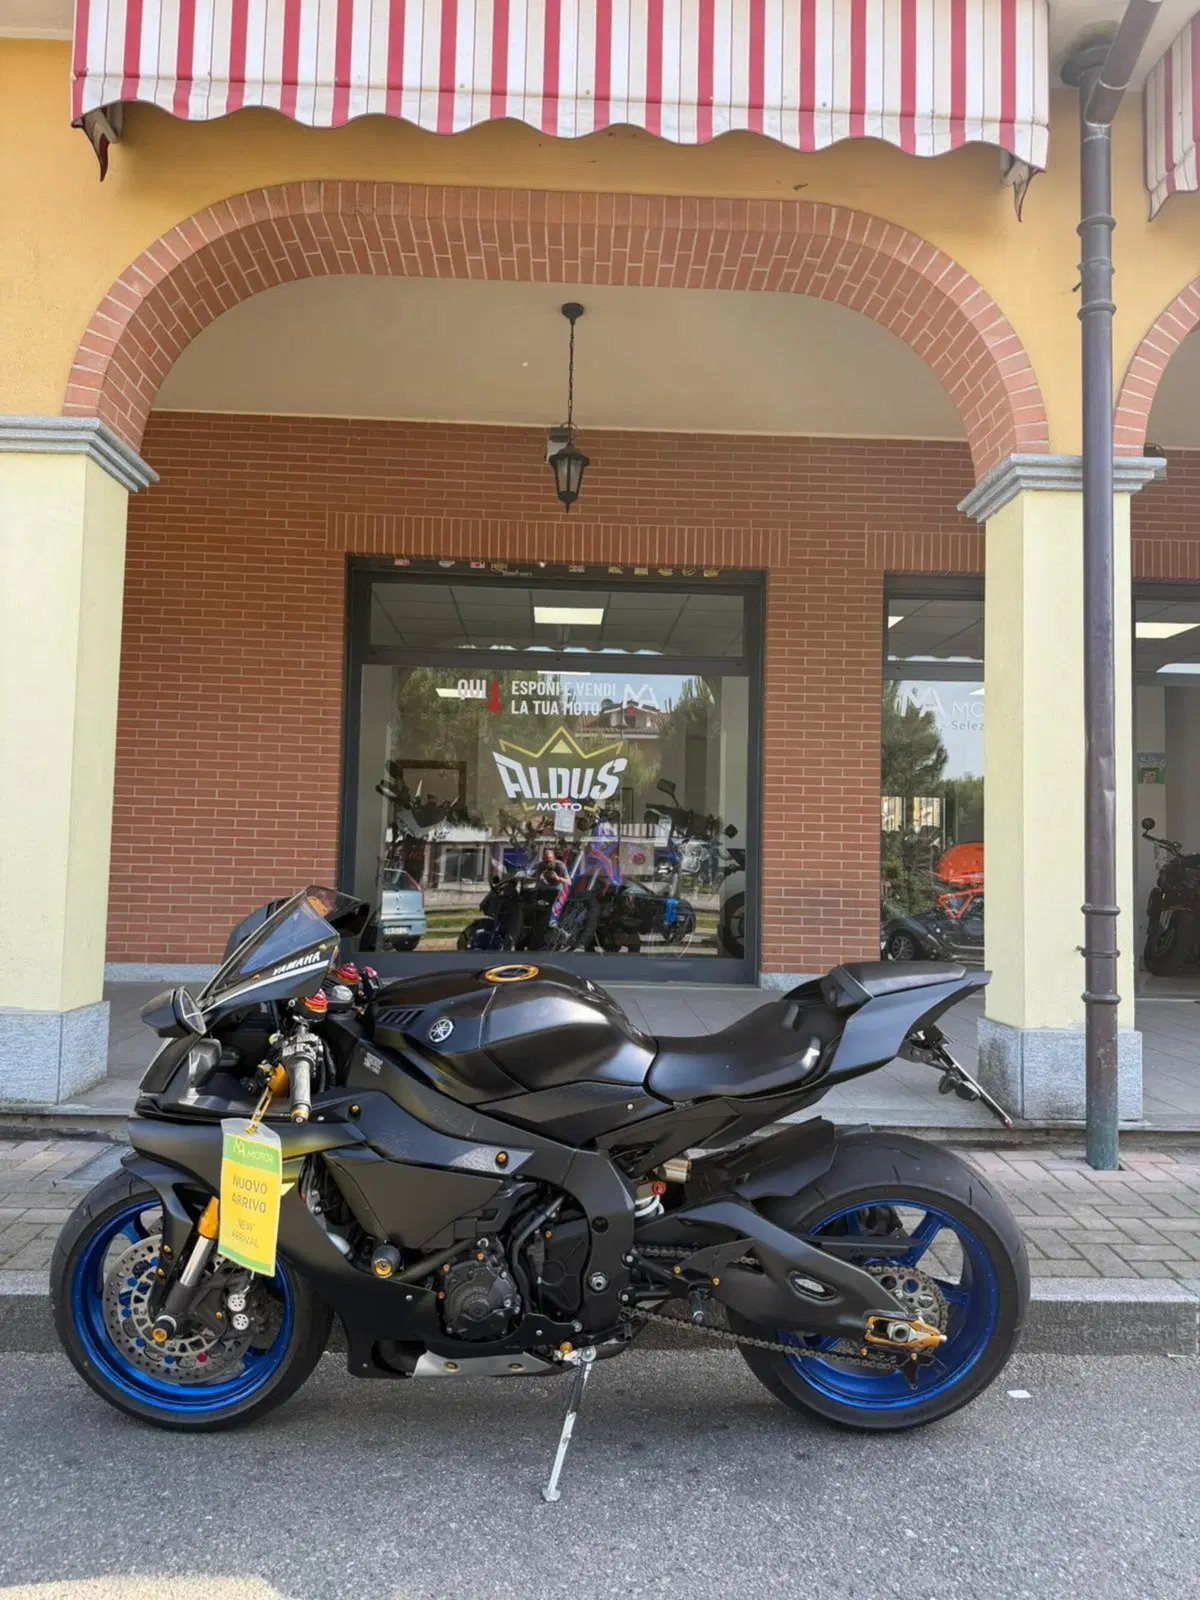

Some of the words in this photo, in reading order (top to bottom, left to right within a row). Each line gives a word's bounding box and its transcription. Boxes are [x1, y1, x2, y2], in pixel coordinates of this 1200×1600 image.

[457, 679, 487, 699] QUI
[511, 680, 560, 696] ESPONI
[565, 682, 573, 697] E
[576, 682, 616, 697] VENDI
[511, 700, 529, 714] LA
[533, 701, 559, 715] TUA
[563, 701, 600, 716] MOTO
[492, 751, 628, 800] ALDUS
[536, 802, 582, 811] MOTO
[272, 951, 320, 976] YAMAHA
[232, 1174, 268, 1195] NUOVO
[232, 1192, 266, 1214] ARRIVO
[237, 1218, 255, 1231] NEW
[231, 1229, 260, 1249] ARRIVAL
